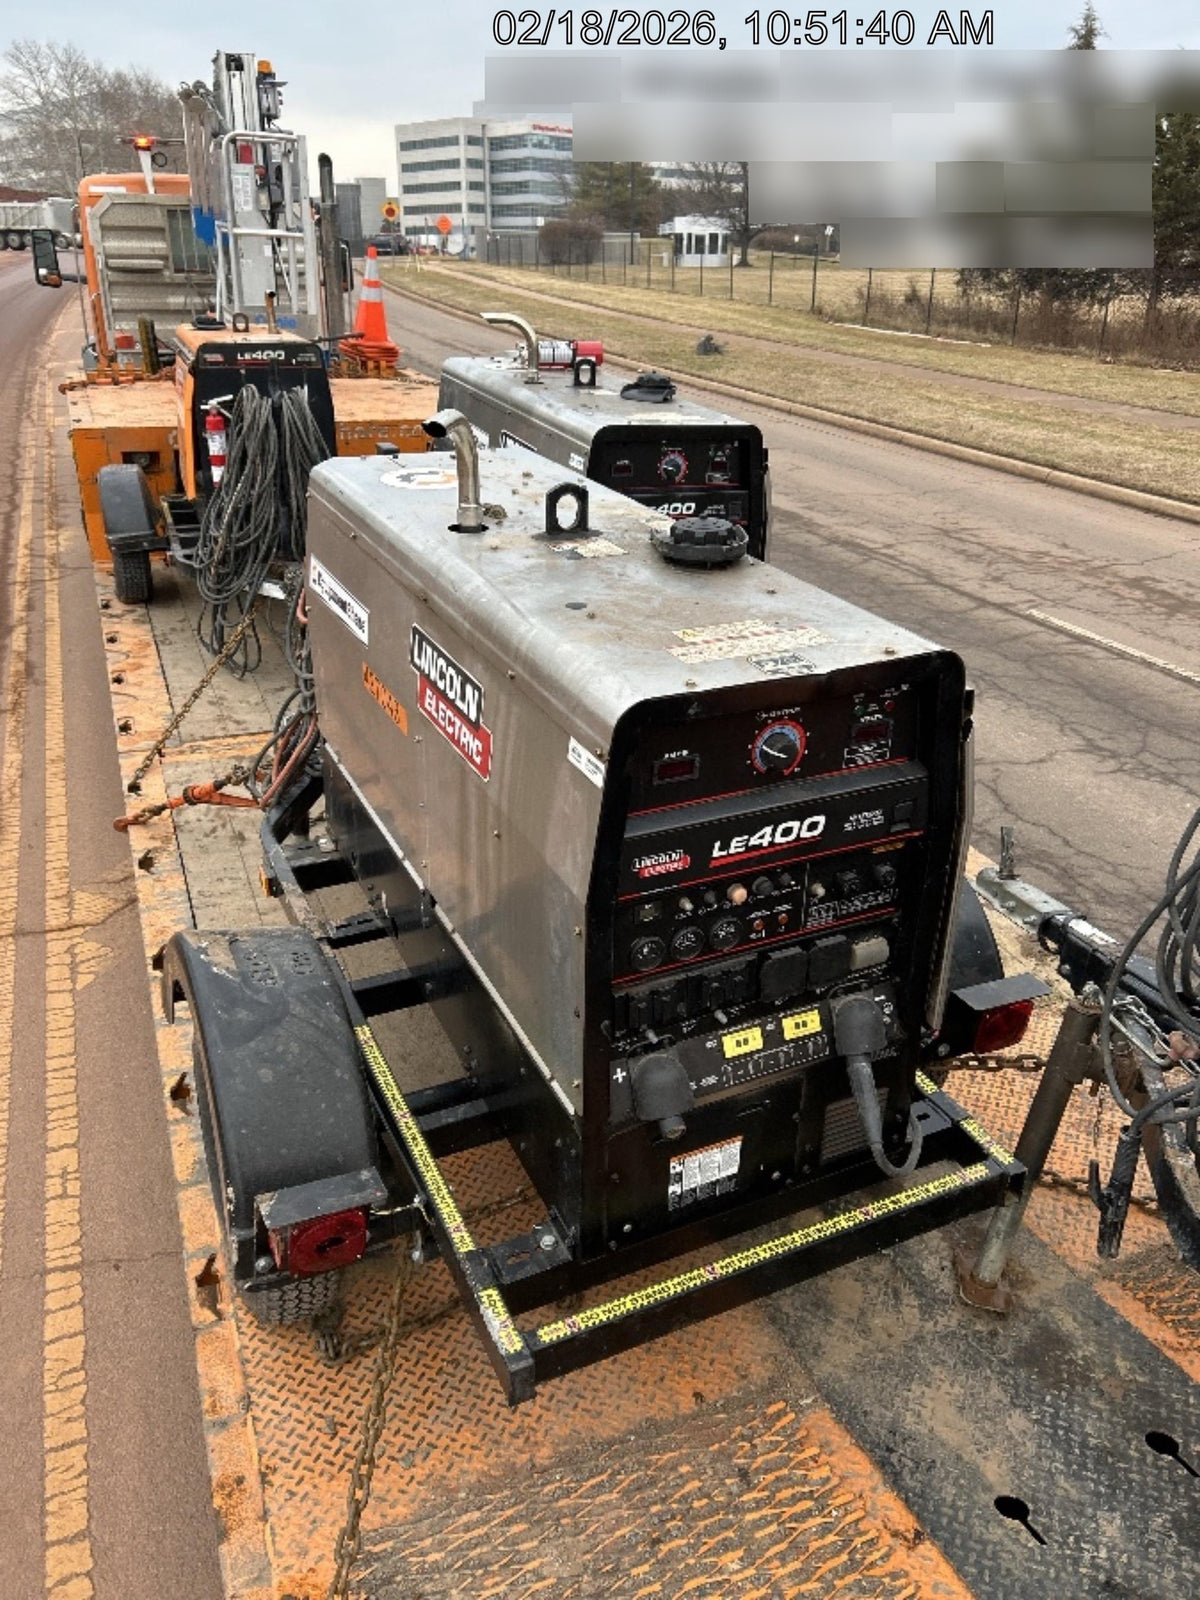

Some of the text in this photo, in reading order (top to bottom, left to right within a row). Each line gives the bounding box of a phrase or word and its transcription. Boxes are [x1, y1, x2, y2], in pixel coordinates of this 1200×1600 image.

[413, 634, 480, 723] LINCOLN
[424, 686, 482, 766] ELECTRIC
[712, 815, 826, 858] LE400
[601, 1300, 626, 1316] NOT
